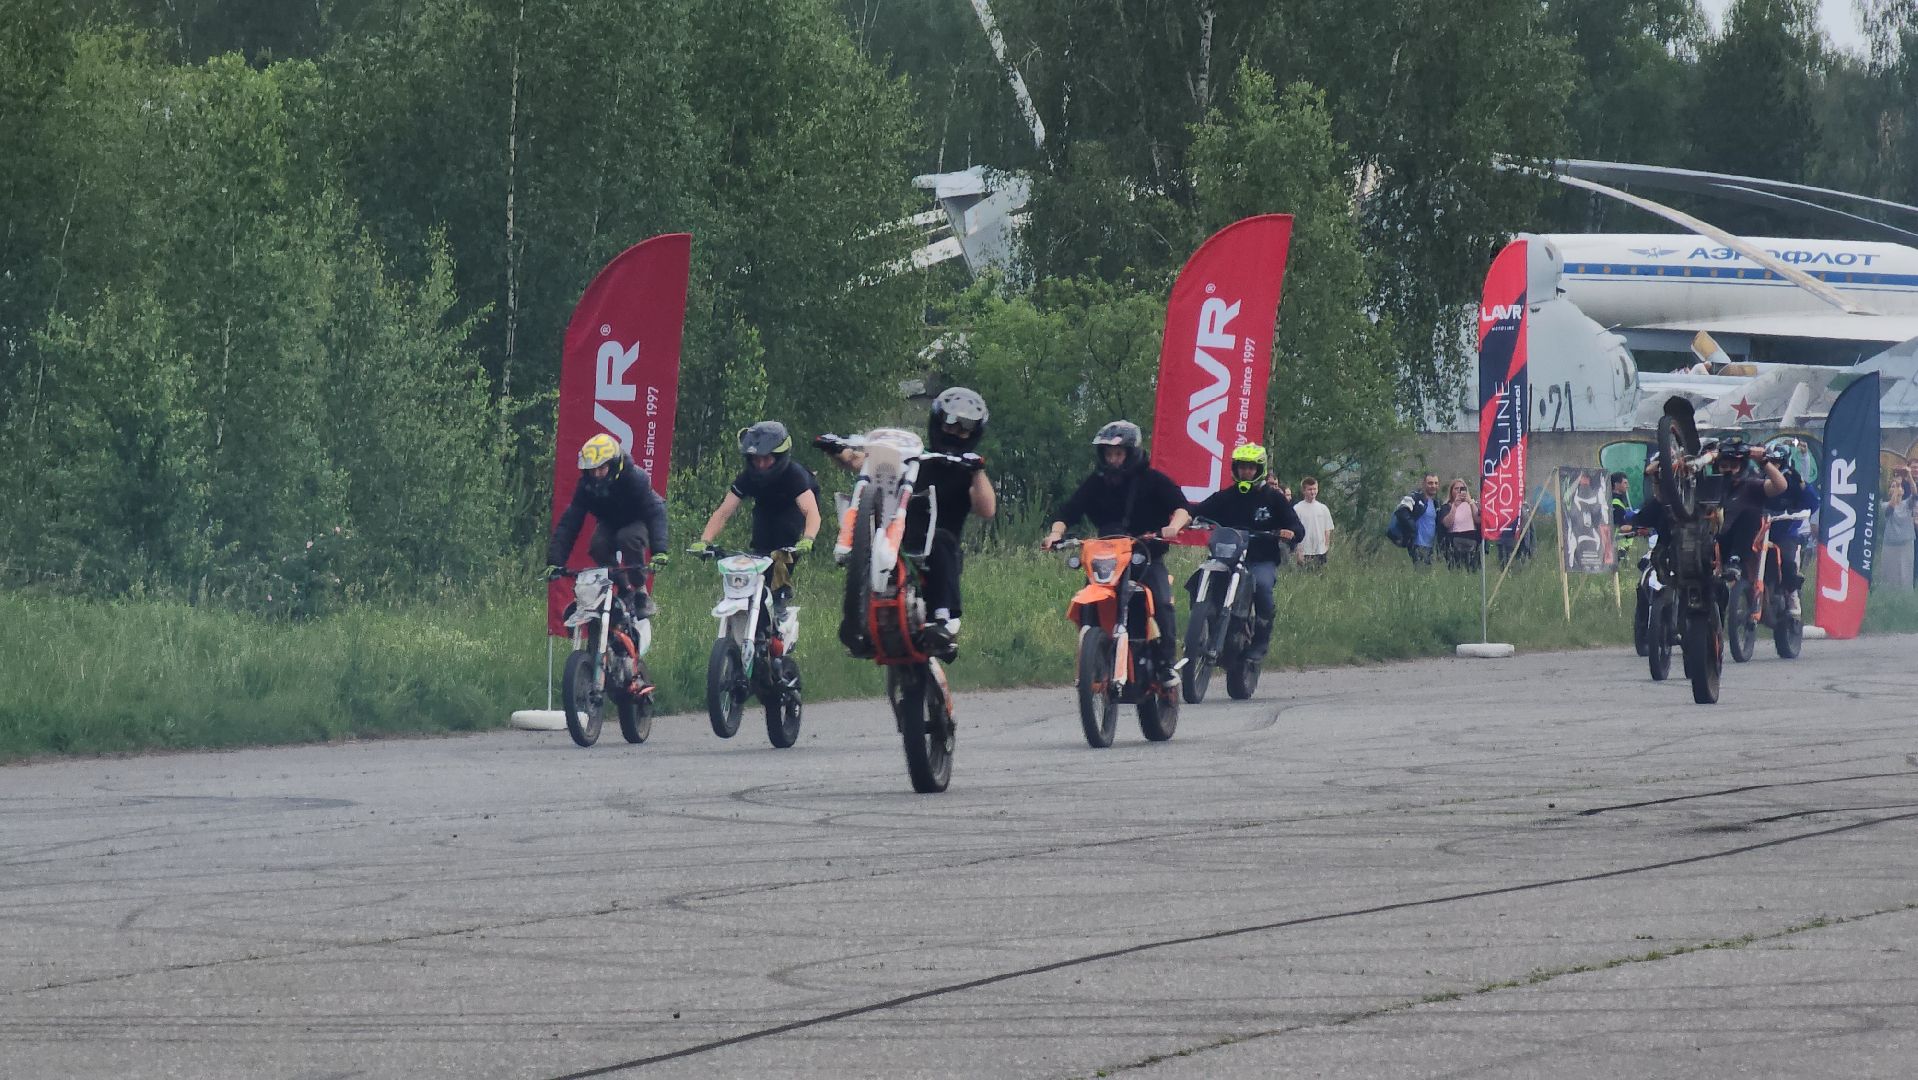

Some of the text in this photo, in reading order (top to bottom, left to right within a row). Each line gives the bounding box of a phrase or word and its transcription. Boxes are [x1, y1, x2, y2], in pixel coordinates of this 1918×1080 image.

[646, 386, 659, 417] 1997
[1234, 337, 1256, 447] ily Brand since 1997
[644, 421, 656, 457] since
[1494, 380, 1514, 532] MOTOLINE
[1484, 458, 1499, 533] LAVR
[1862, 492, 1875, 571] MOTOLINE
